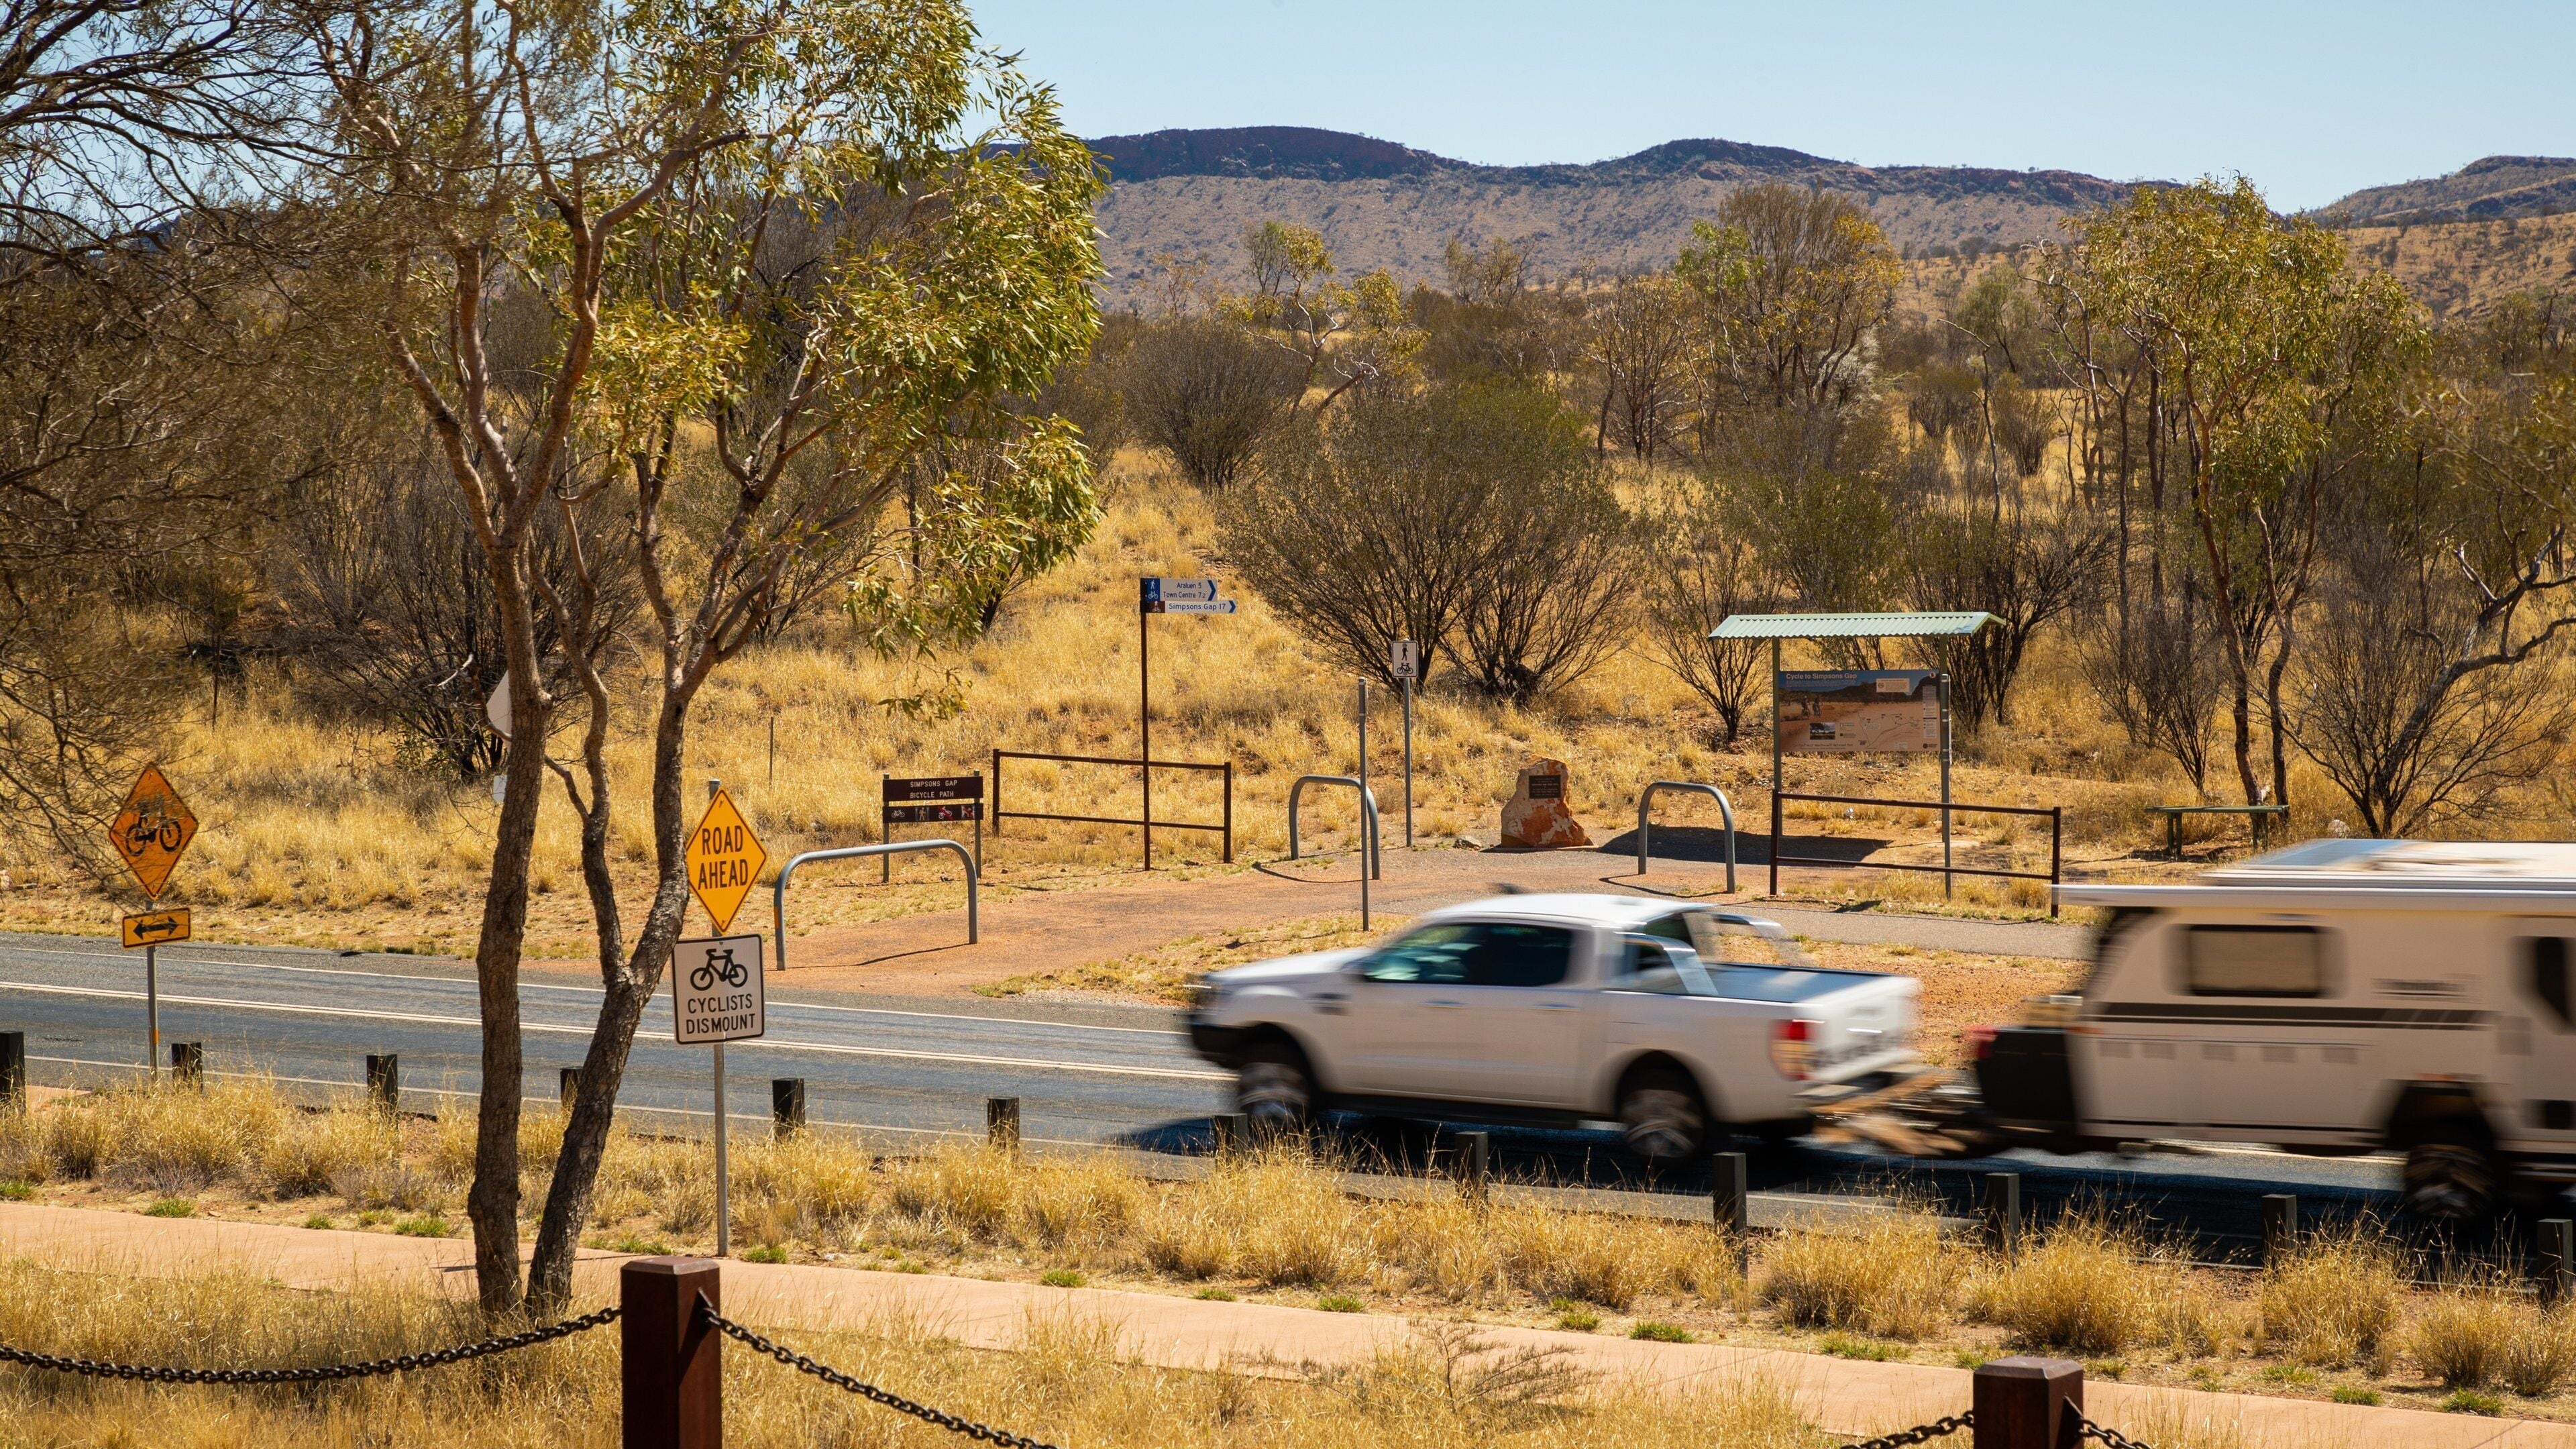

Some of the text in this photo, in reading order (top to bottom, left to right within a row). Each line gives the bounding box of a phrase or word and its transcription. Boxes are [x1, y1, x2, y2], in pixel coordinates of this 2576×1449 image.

[1169, 603, 1201, 611] Simpsons
[1203, 603, 1217, 611] Gap
[702, 825, 743, 856] ROAD
[698, 859, 749, 890] AHEAD
[688, 993, 753, 1014] CYCLISTS
[686, 1013, 755, 1034] DISMOUNT
